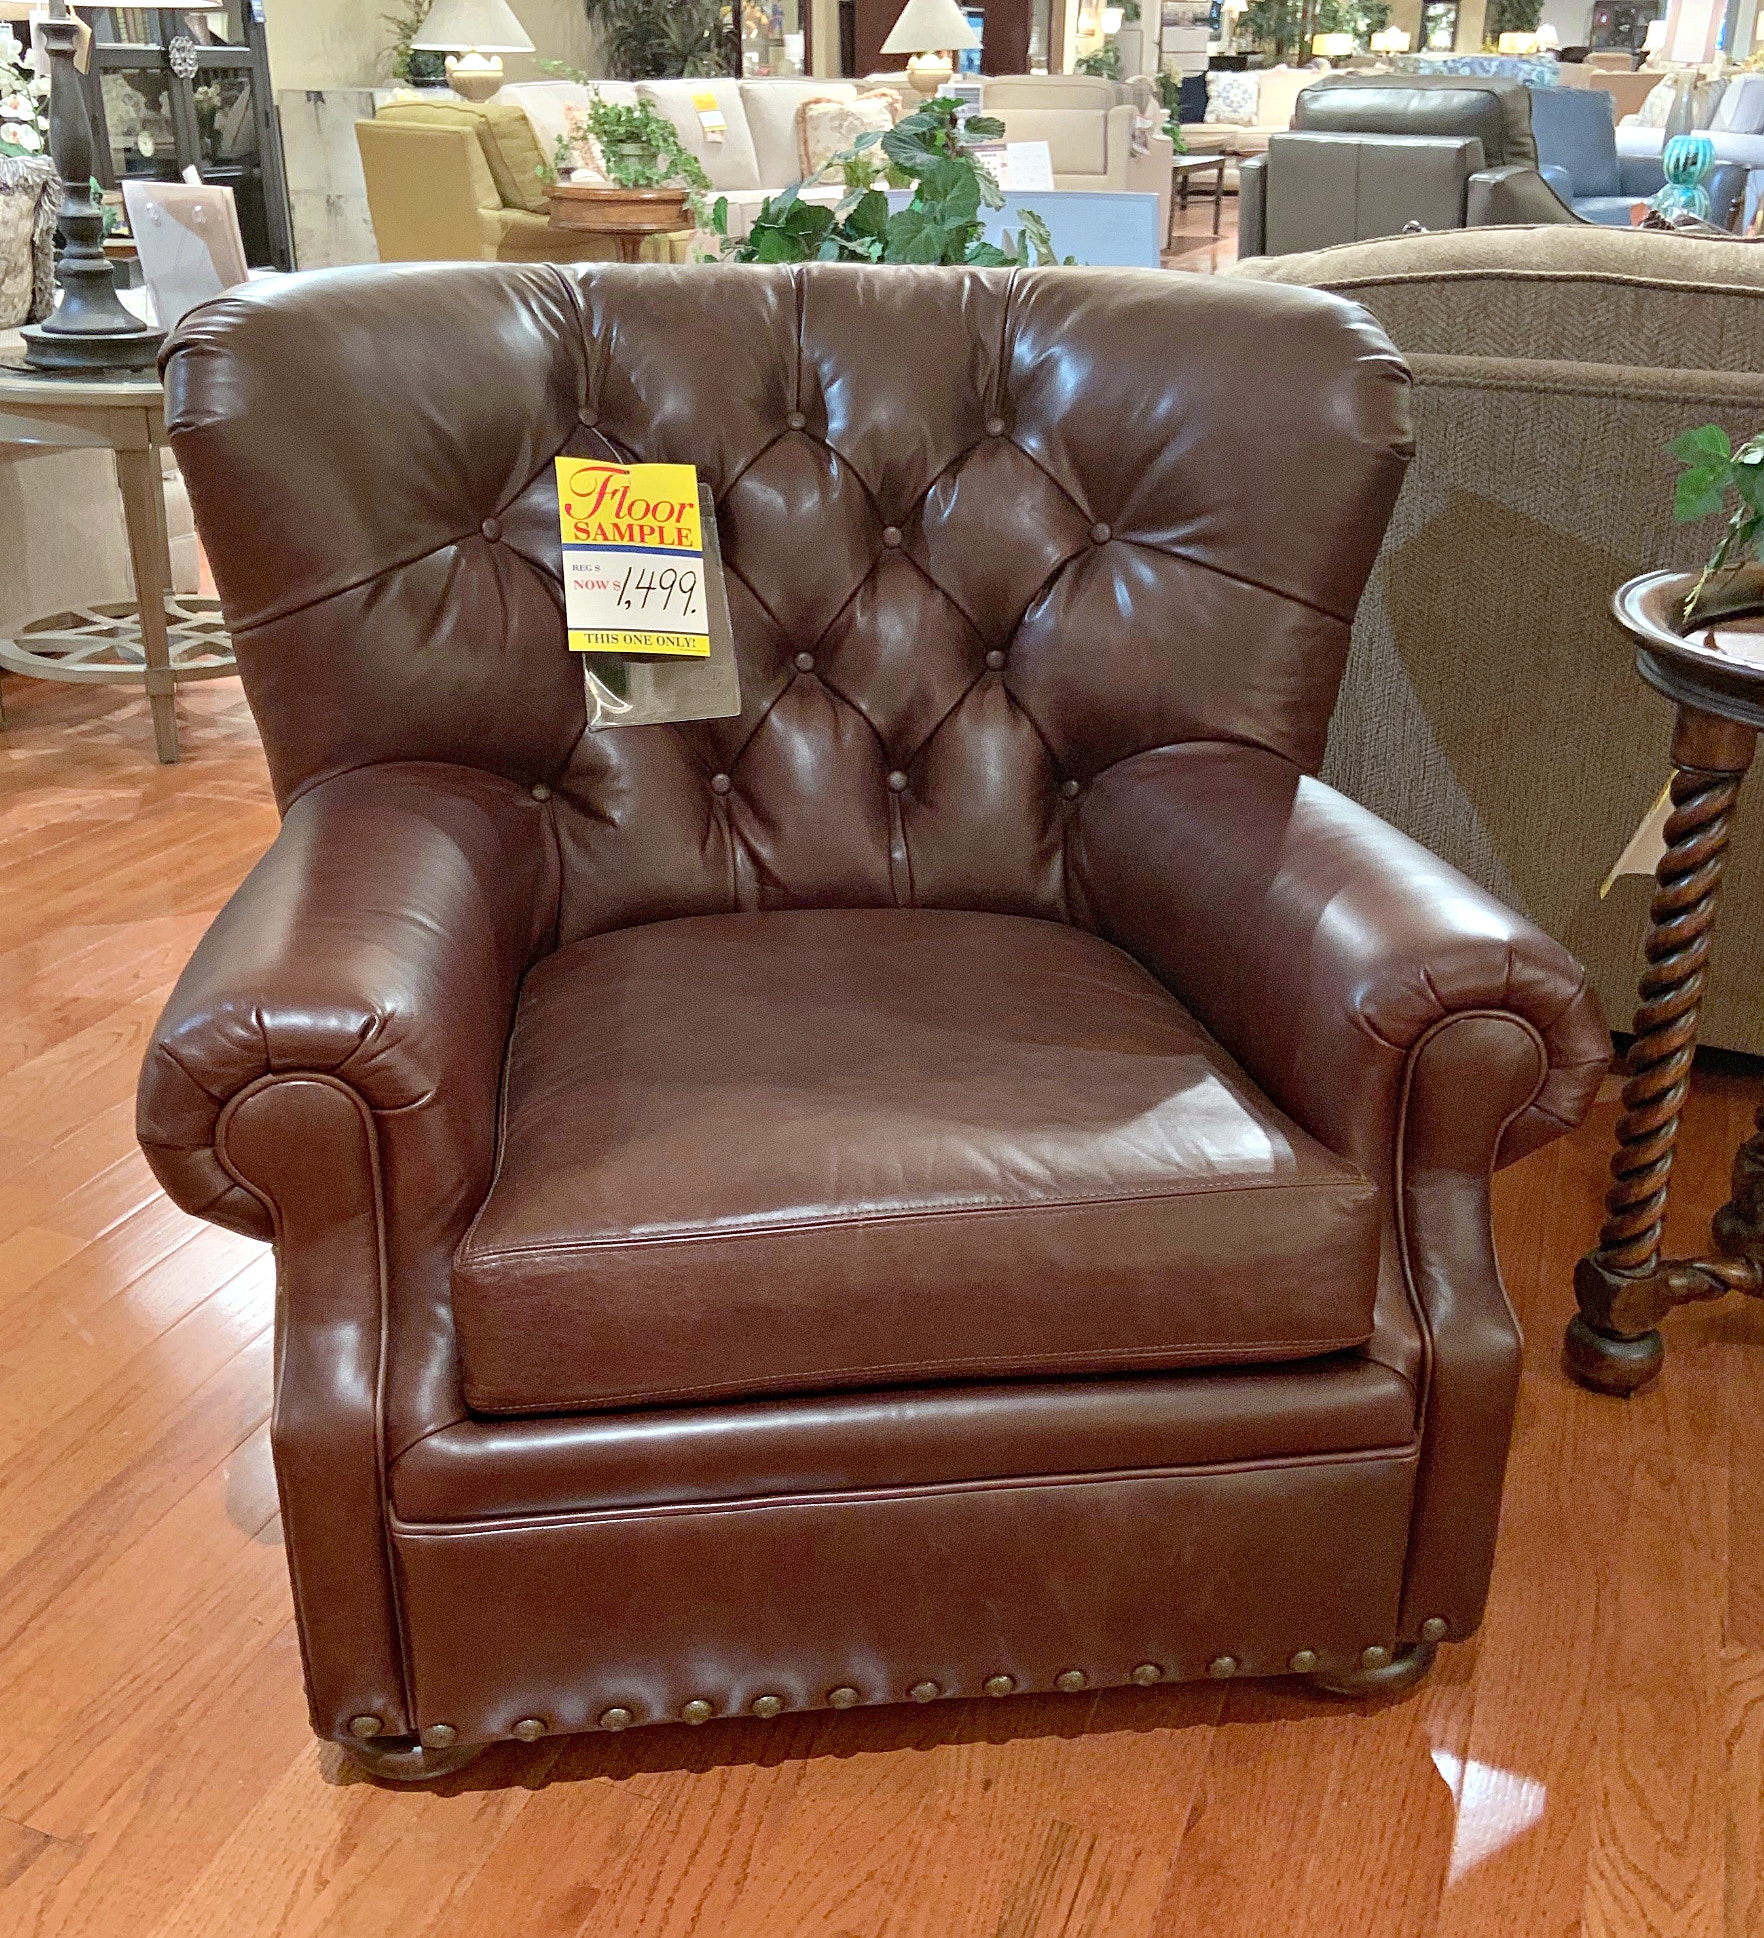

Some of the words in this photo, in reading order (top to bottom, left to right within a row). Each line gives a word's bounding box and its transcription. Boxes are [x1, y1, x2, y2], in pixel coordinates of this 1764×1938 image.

[564, 466, 694, 524] Floor
[573, 521, 694, 548] SAMPLE
[572, 564, 592, 572] REG
[573, 580, 610, 591] NOW
[584, 633, 619, 644] THIS
[623, 634, 653, 646] ONE
[656, 635, 696, 648] ONLY!
